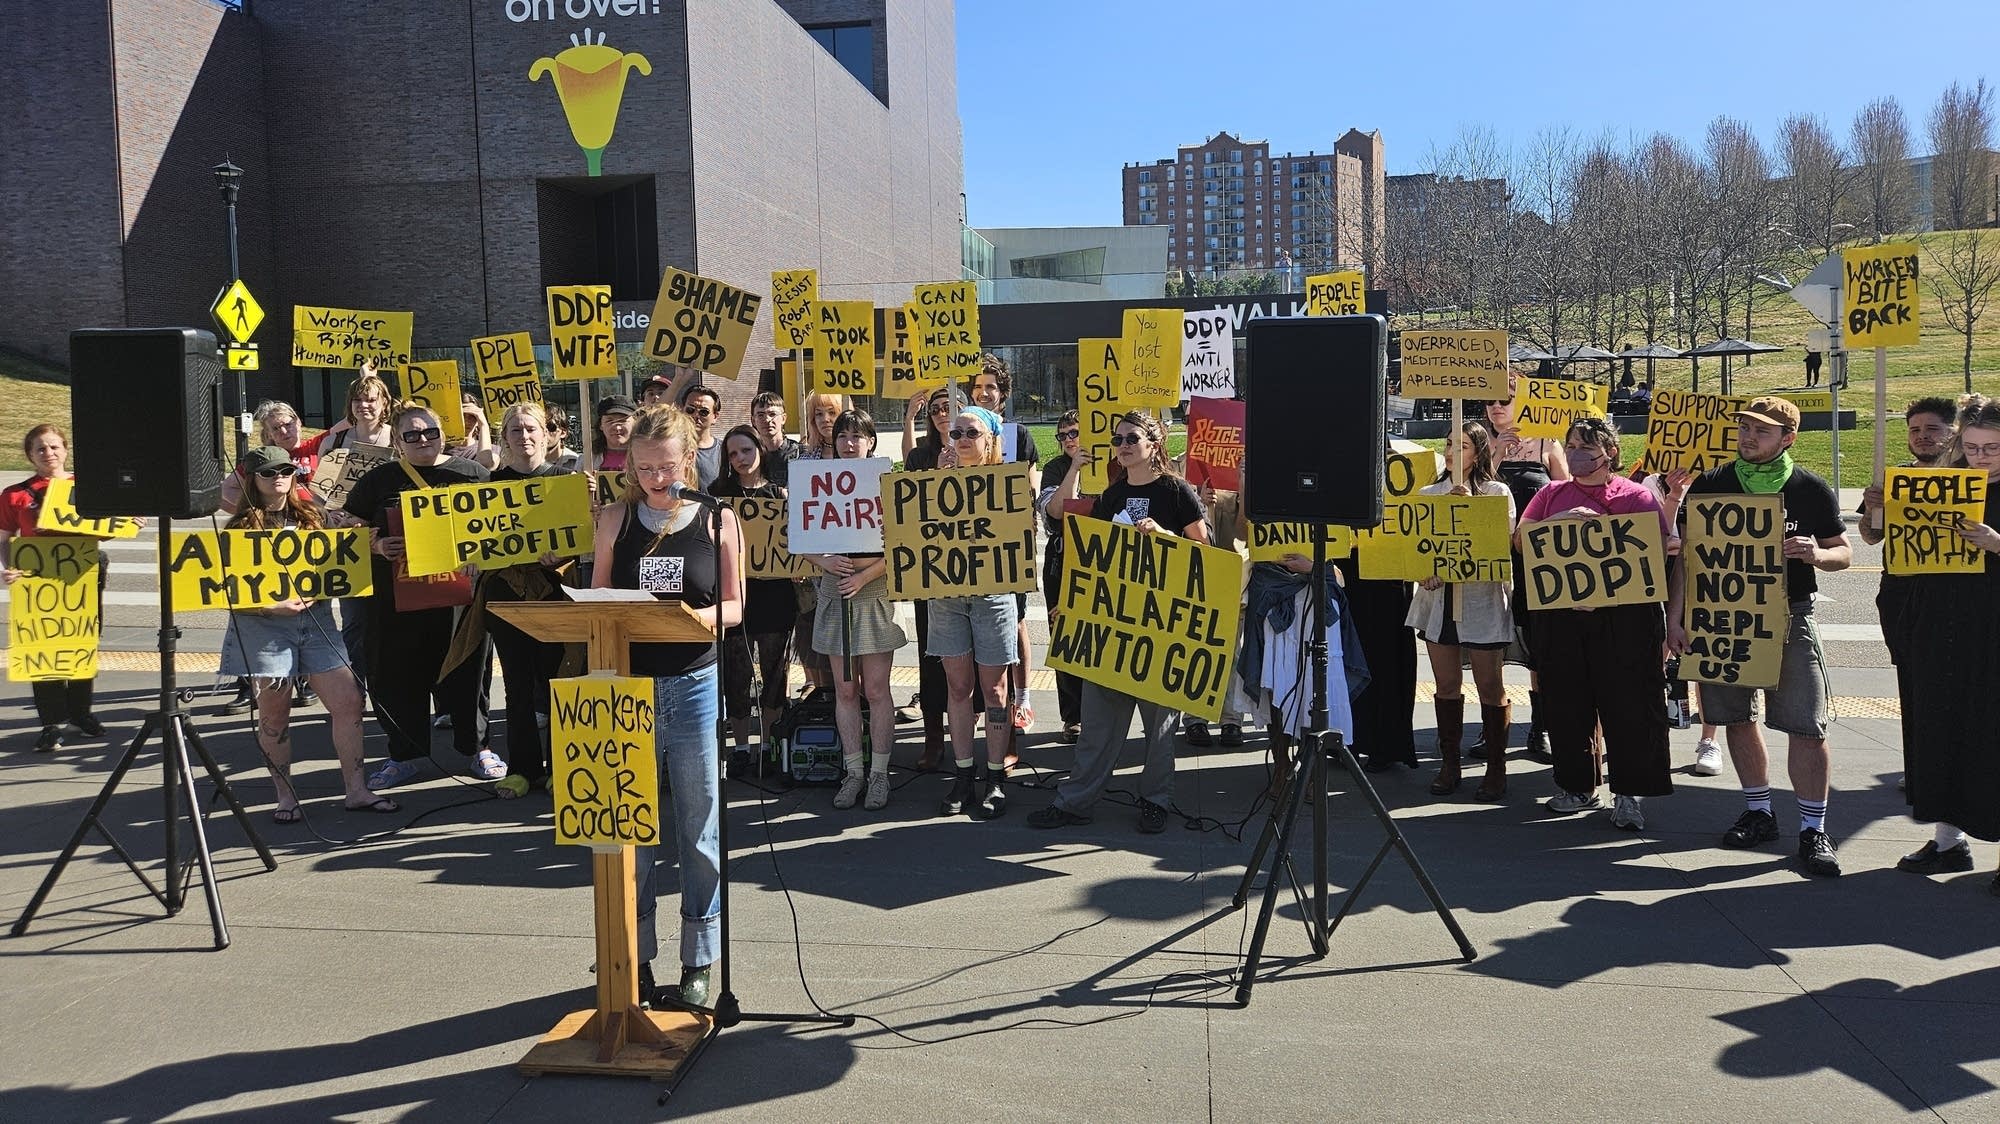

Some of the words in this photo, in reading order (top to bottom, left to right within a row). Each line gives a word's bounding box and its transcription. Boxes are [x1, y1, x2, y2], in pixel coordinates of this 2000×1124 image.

[506, 0, 554, 22] on
[668, 274, 761, 326] SHAME
[921, 288, 965, 305] CAN
[1310, 281, 1360, 309] PEOPLE
[1857, 278, 1907, 305] BITE
[675, 309, 721, 340] ON
[821, 307, 840, 324] AI
[925, 308, 965, 327] YOU
[1136, 314, 1157, 335] You
[1183, 317, 1226, 339] DDP
[1849, 303, 1911, 335] BACK
[652, 328, 726, 369] DDP
[820, 326, 870, 345] TOOK
[925, 331, 971, 348] HEAR
[1133, 336, 1162, 359] lost
[478, 340, 534, 374] PPL
[554, 335, 614, 368] WTF?
[830, 348, 853, 364] MY
[922, 355, 940, 370] US
[947, 352, 979, 367] NOW?
[1185, 351, 1220, 367] ANTI
[1404, 355, 1507, 370] MEDITERRANEAN
[824, 369, 866, 390] JOB
[1133, 362, 1160, 380] this
[1182, 368, 1235, 393] WORKER
[1406, 374, 1492, 389] APPLEBEES.
[484, 381, 542, 413] PROFITS
[1529, 381, 1598, 404] RESIST
[1517, 404, 1600, 425] AUTOMAT
[1650, 419, 1738, 452] PEOPLE
[1643, 448, 1685, 473] NOT
[811, 471, 856, 497] NO
[1891, 475, 1984, 504] PEOPLE
[410, 484, 544, 518] PEOPLE
[894, 474, 1027, 524] PEOPLE
[467, 512, 524, 533] OVER
[920, 517, 995, 541] OVER
[1369, 504, 1470, 537] EOPLE
[1696, 502, 1772, 539] YOU
[1903, 507, 1966, 529] OVER
[170, 531, 231, 572] AI
[244, 530, 360, 566] TOOK
[457, 526, 577, 561] PROFIT
[1417, 538, 1472, 559] OVER
[1528, 519, 1648, 558] FUCK
[15, 543, 80, 578] QR
[892, 530, 1034, 593] PROFIT!
[1067, 515, 1177, 591] WHAT
[1186, 545, 1205, 602] A
[1434, 559, 1510, 580] PROFIT
[1695, 542, 1783, 574] WILL
[23, 583, 86, 613] YOU
[200, 573, 265, 604] MY
[269, 569, 351, 602] JOB
[1696, 572, 1777, 604] NOT
[1066, 568, 1226, 646] FALAFEL
[1691, 607, 1773, 639] REPL
[1050, 615, 1111, 668] WAY
[1114, 630, 1154, 682] TO
[1162, 642, 1226, 707] GO!
[1685, 636, 1751, 662] ACE
[1698, 660, 1740, 682] US
[566, 739, 640, 768] over
